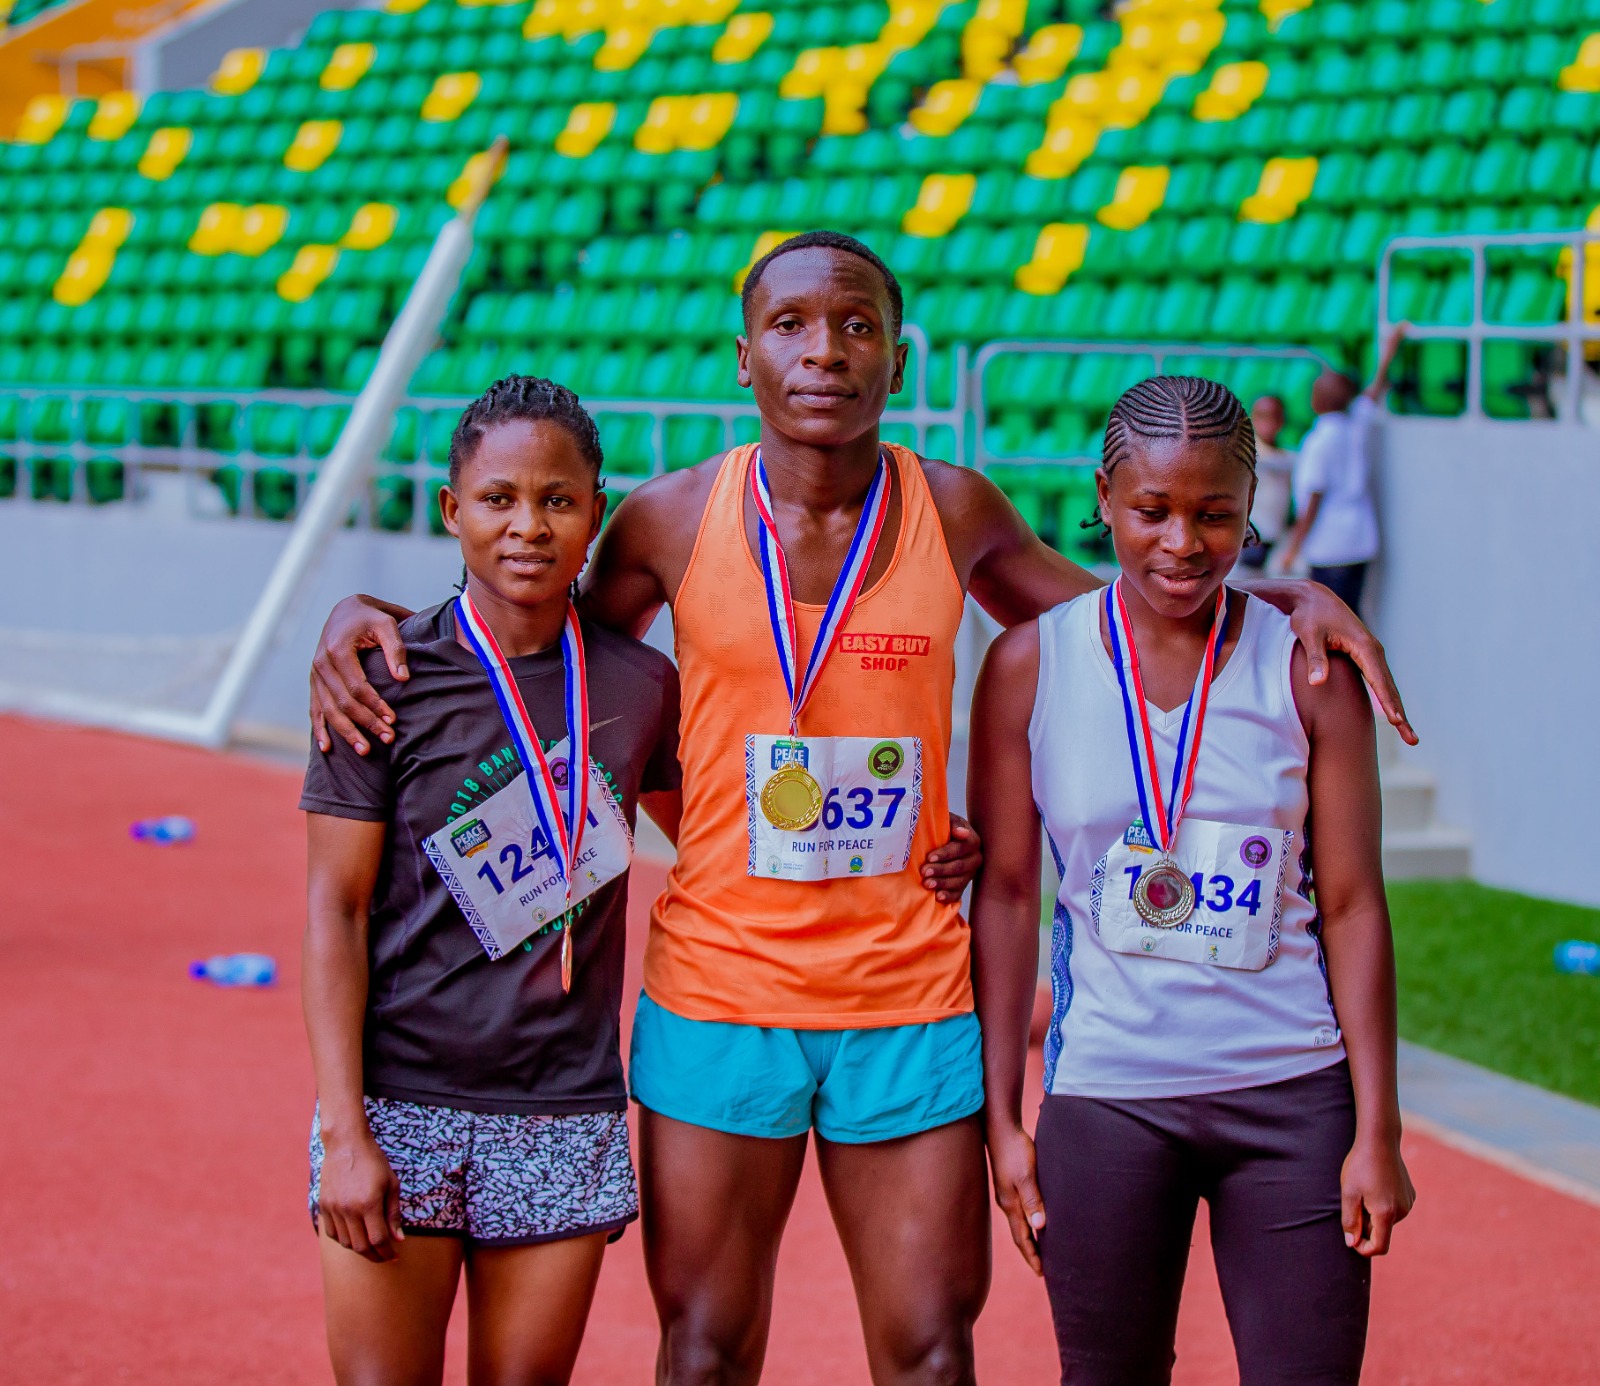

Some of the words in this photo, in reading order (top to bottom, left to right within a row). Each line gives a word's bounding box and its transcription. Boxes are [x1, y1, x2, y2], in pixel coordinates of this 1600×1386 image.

[842, 635, 889, 651] EASY
[892, 637, 927, 653] BUY
[861, 656, 908, 671] SHOP
[477, 743, 520, 777] BAN
[772, 787, 906, 831] 637
[453, 823, 485, 850] PEACE
[792, 841, 816, 853] RUN
[818, 840, 835, 852] FOR
[838, 838, 874, 850] PEACE
[519, 885, 543, 907] RUN
[542, 871, 564, 891] FOR
[571, 846, 598, 872] EACE
[1124, 864, 1262, 916] 1434
[1195, 924, 1233, 939] PEACE
